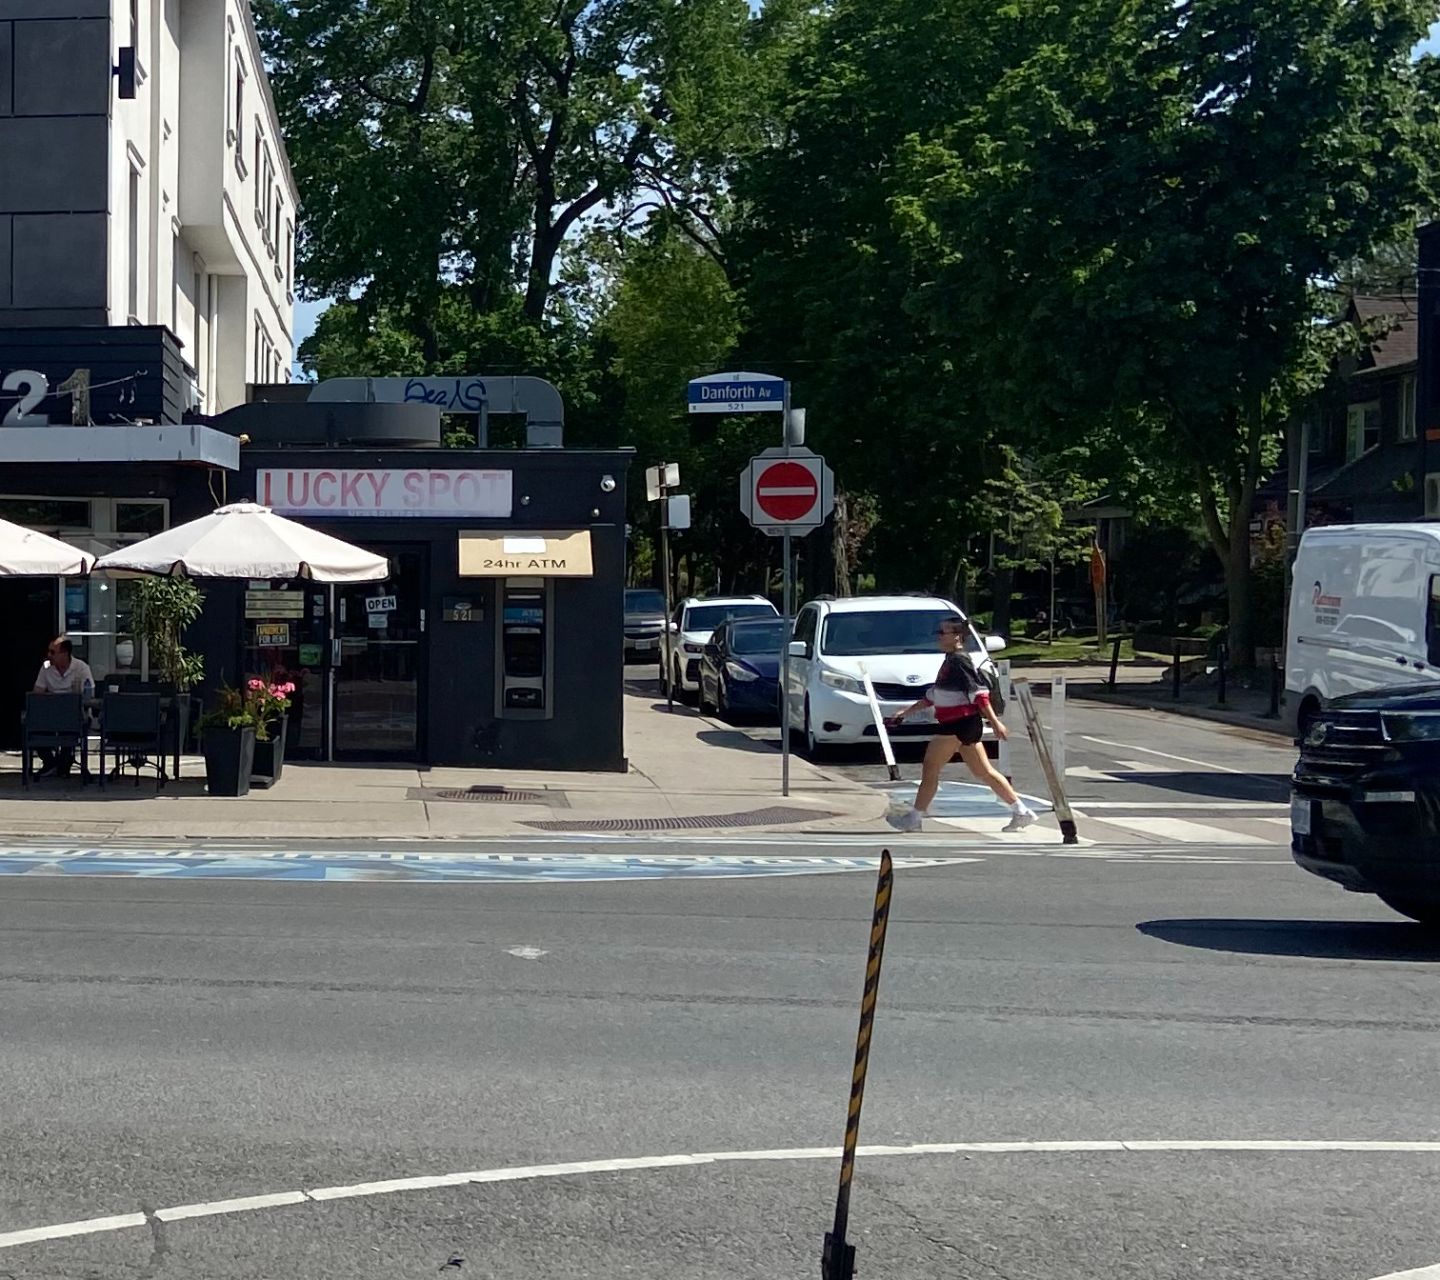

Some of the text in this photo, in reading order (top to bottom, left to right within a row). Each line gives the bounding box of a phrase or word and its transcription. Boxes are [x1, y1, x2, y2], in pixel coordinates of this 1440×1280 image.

[701, 385, 771, 400] Danforth Av
[264, 472, 506, 507] LUCKY SPOT
[483, 559, 566, 569] 24hr ATM
[368, 598, 395, 610] OPEN
[453, 609, 472, 620] 521
[521, 609, 543, 617] ATM
